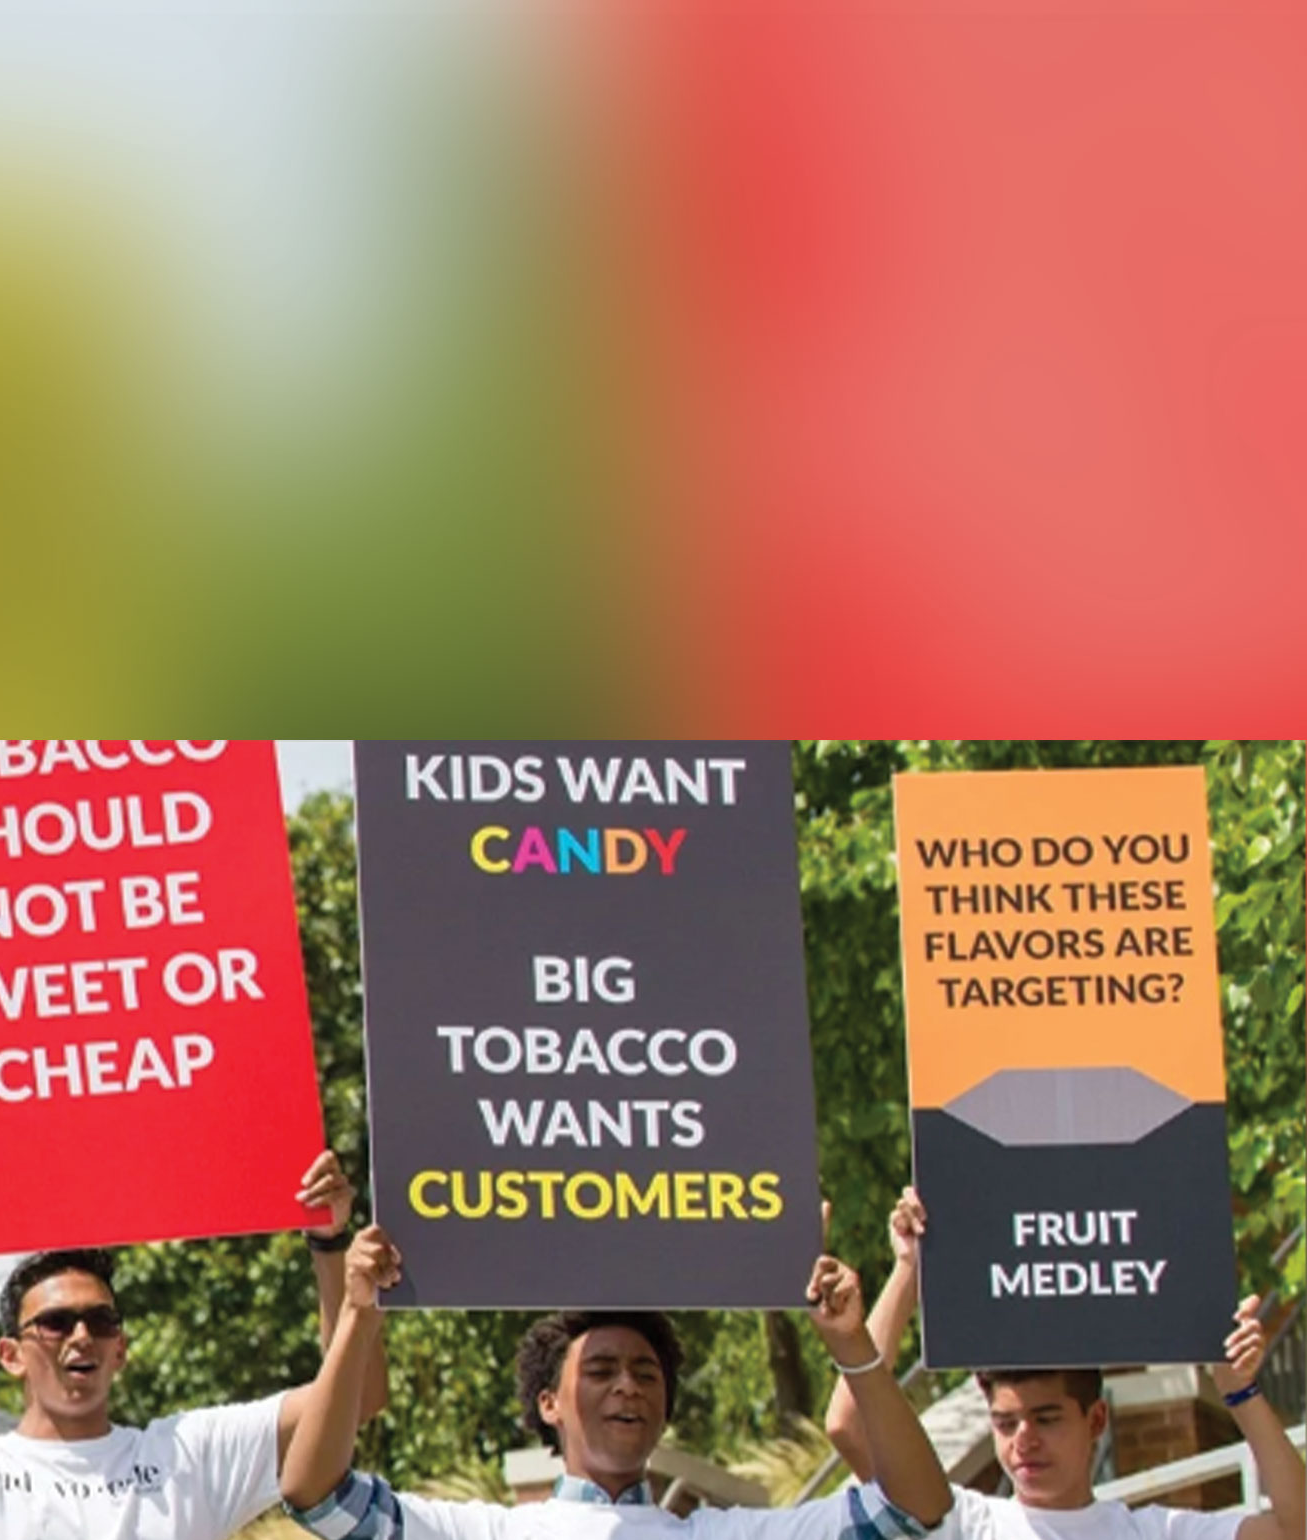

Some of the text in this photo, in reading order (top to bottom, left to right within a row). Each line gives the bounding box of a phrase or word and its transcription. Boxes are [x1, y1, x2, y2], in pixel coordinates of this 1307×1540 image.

[405, 755, 746, 805] KIDS WANT
[470, 825, 687, 876] CANDY
[916, 833, 1189, 868] WHO DO YOU
[121, 871, 205, 929] BE
[925, 880, 1186, 915] THINK THESE
[925, 927, 1193, 962] FLAVORS ARE
[163, 949, 264, 1006] OR
[533, 956, 635, 1003] BIG
[938, 973, 1185, 1008] TARGETING?
[437, 1026, 737, 1076] TOBACCO
[477, 1099, 705, 1147] WANTS
[409, 1171, 783, 1220] CUSTOMERS
[1013, 1210, 1138, 1247] FRUIT
[991, 1260, 1167, 1299] MEDLEY
